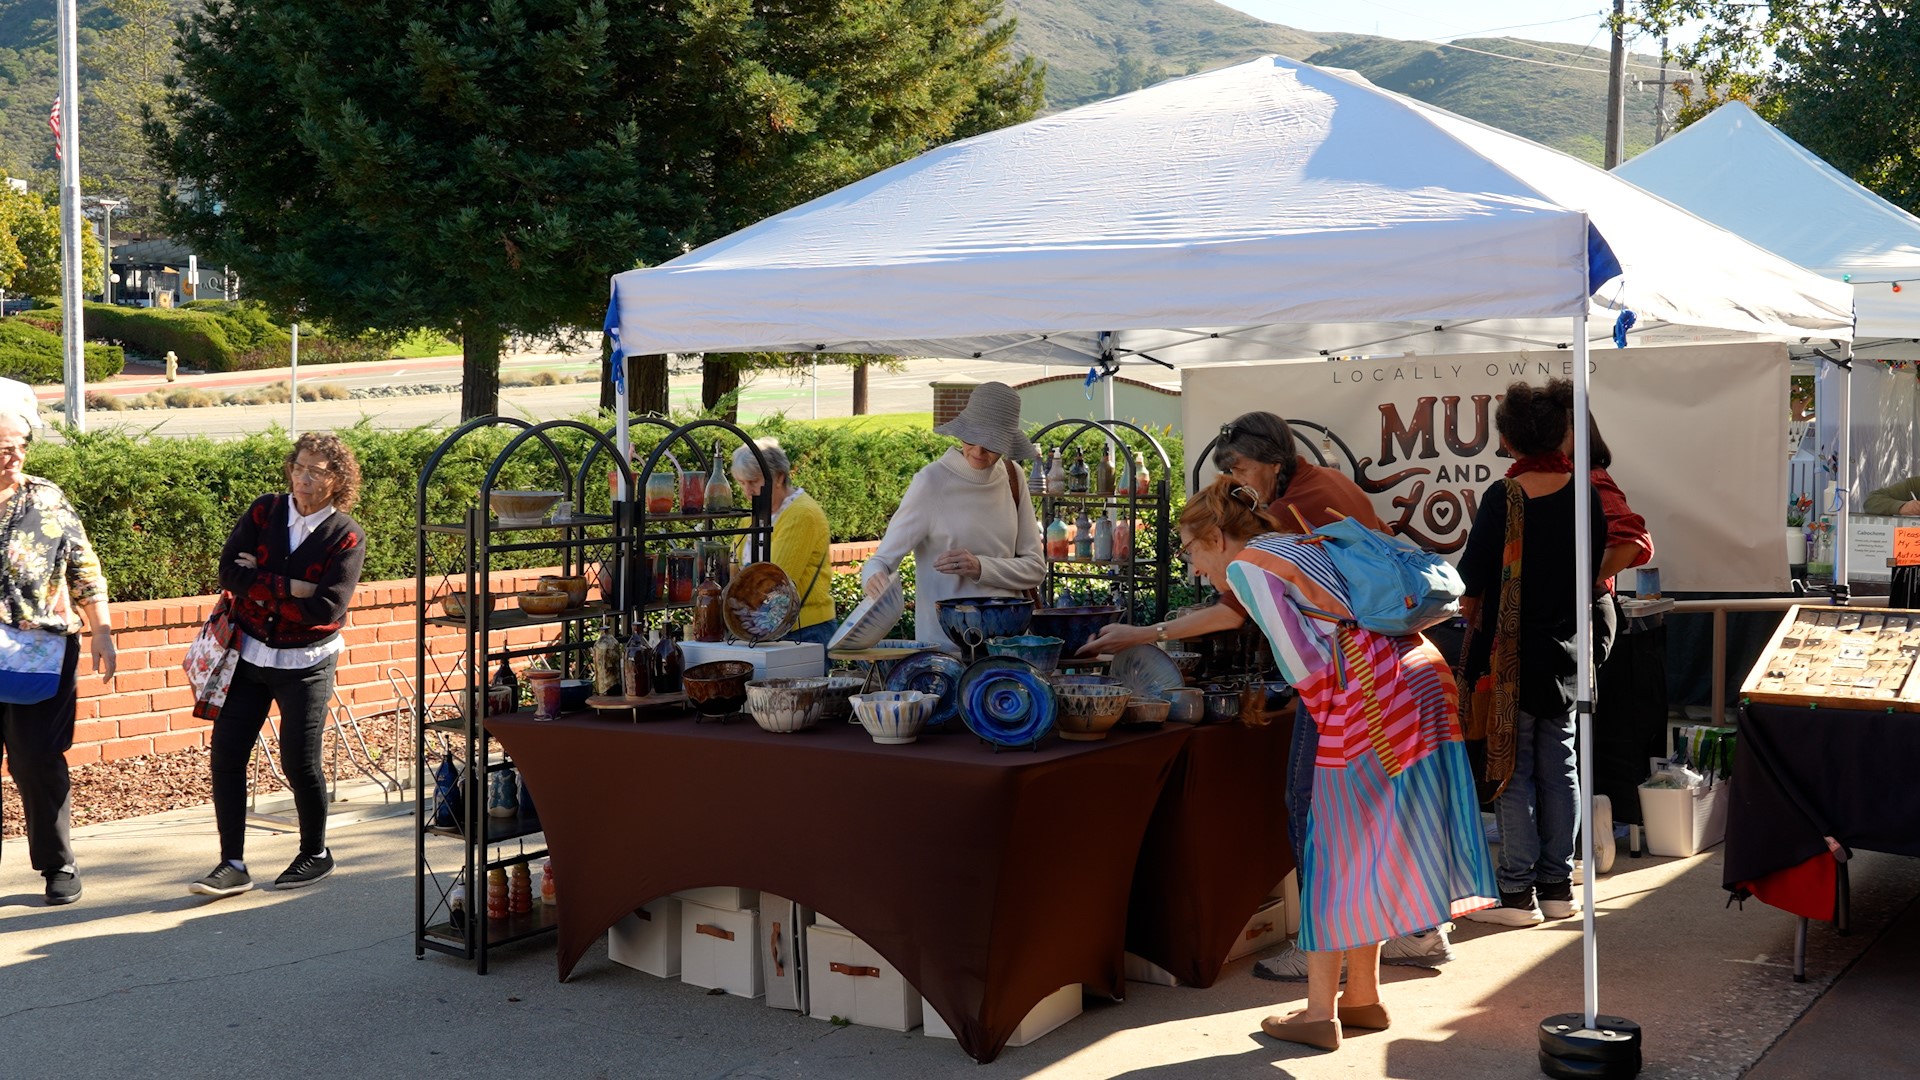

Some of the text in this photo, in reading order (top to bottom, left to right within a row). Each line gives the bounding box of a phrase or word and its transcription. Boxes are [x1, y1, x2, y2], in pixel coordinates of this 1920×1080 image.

[1333, 365, 1462, 384] LOCALLY
[1436, 464, 1491, 484] AND
[1898, 530, 1920, 538] Pleas
[1897, 540, 1910, 549] My
